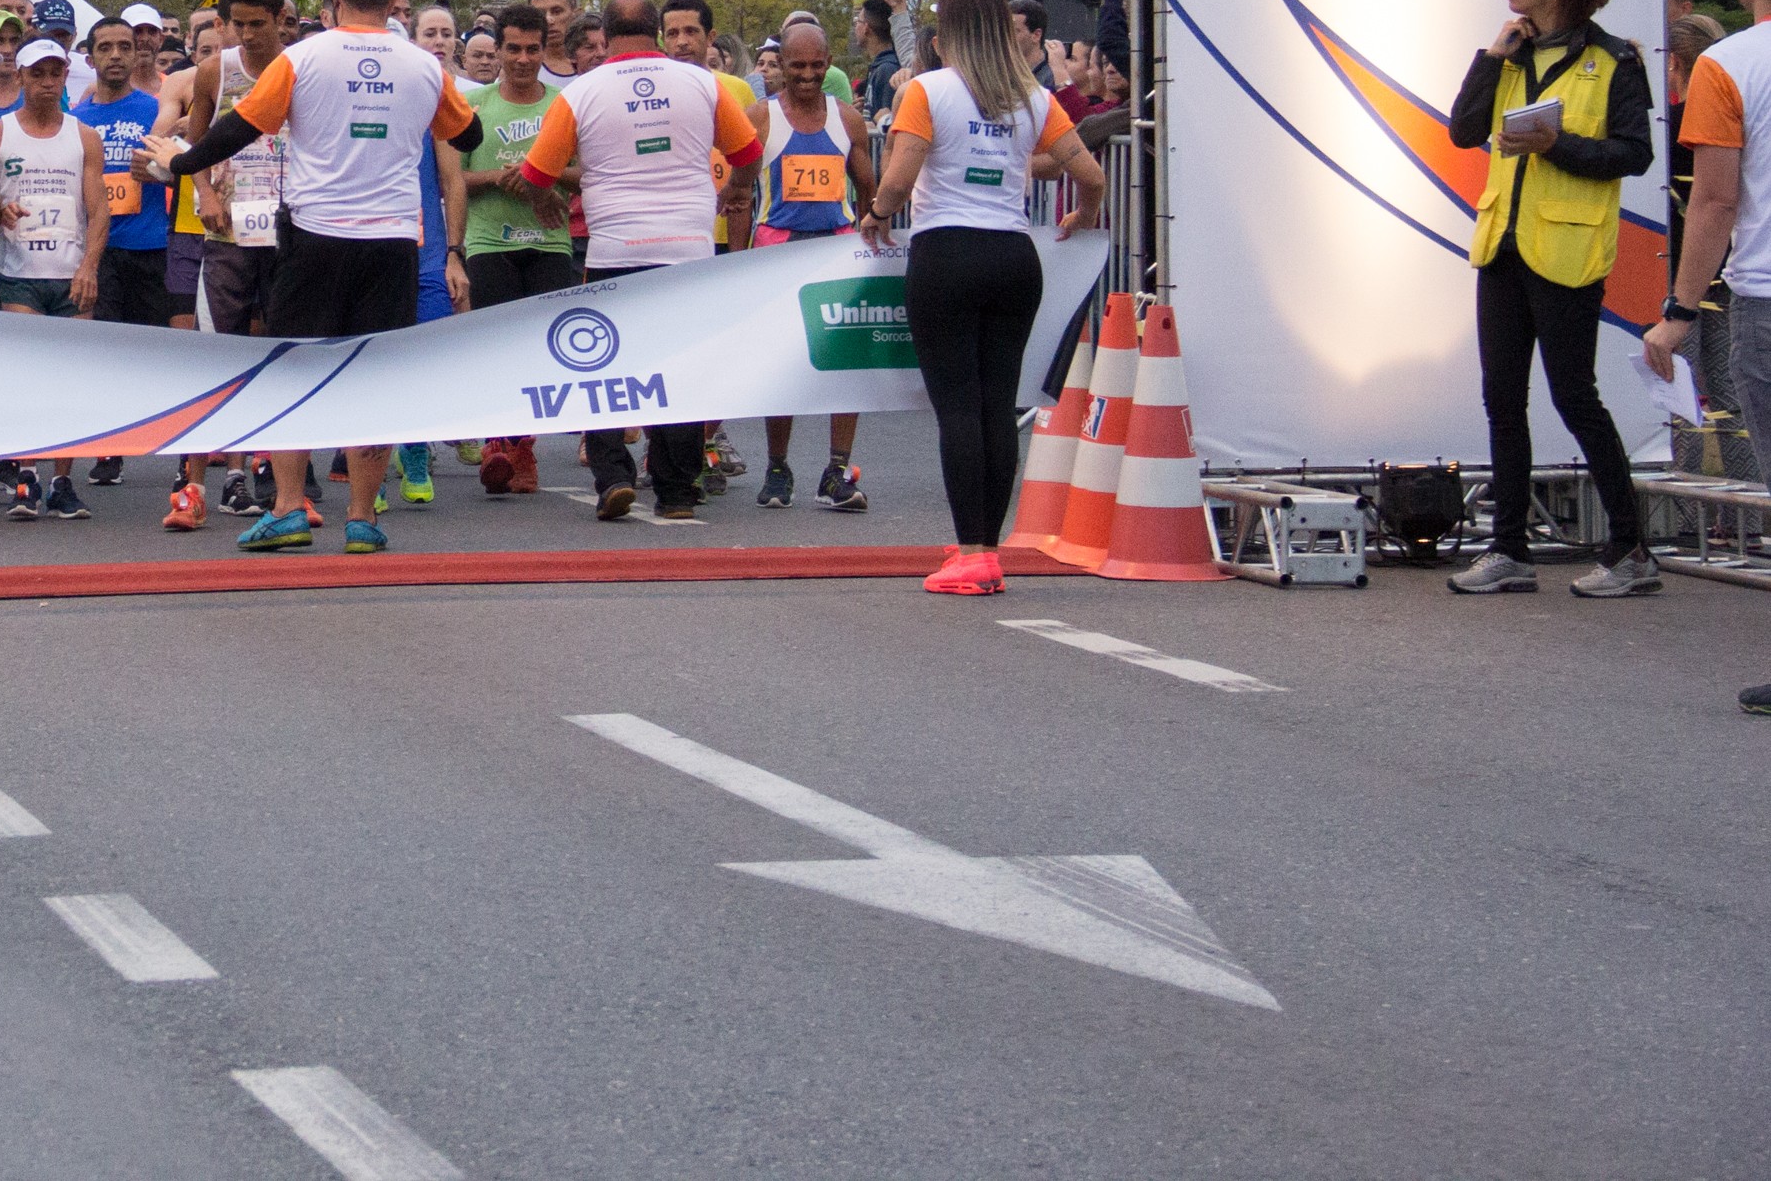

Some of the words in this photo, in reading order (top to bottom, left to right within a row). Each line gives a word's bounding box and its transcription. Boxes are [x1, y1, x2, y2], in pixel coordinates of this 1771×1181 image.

[343, 44, 393, 53] Realização
[616, 65, 665, 76] Realização
[346, 80, 363, 93] TV
[365, 81, 394, 94] TEM
[625, 100, 641, 113] TV
[643, 97, 670, 111] TEM
[983, 123, 1014, 138] TEM
[104, 144, 134, 161] JOÃ
[714, 163, 724, 180] 9
[794, 169, 830, 186] 718
[38, 209, 61, 226] 17
[28, 240, 57, 251] ITU
[820, 300, 908, 325] Unime
[872, 330, 913, 342] Soroca
[521, 382, 573, 419] TV
[579, 373, 668, 415] TEM
